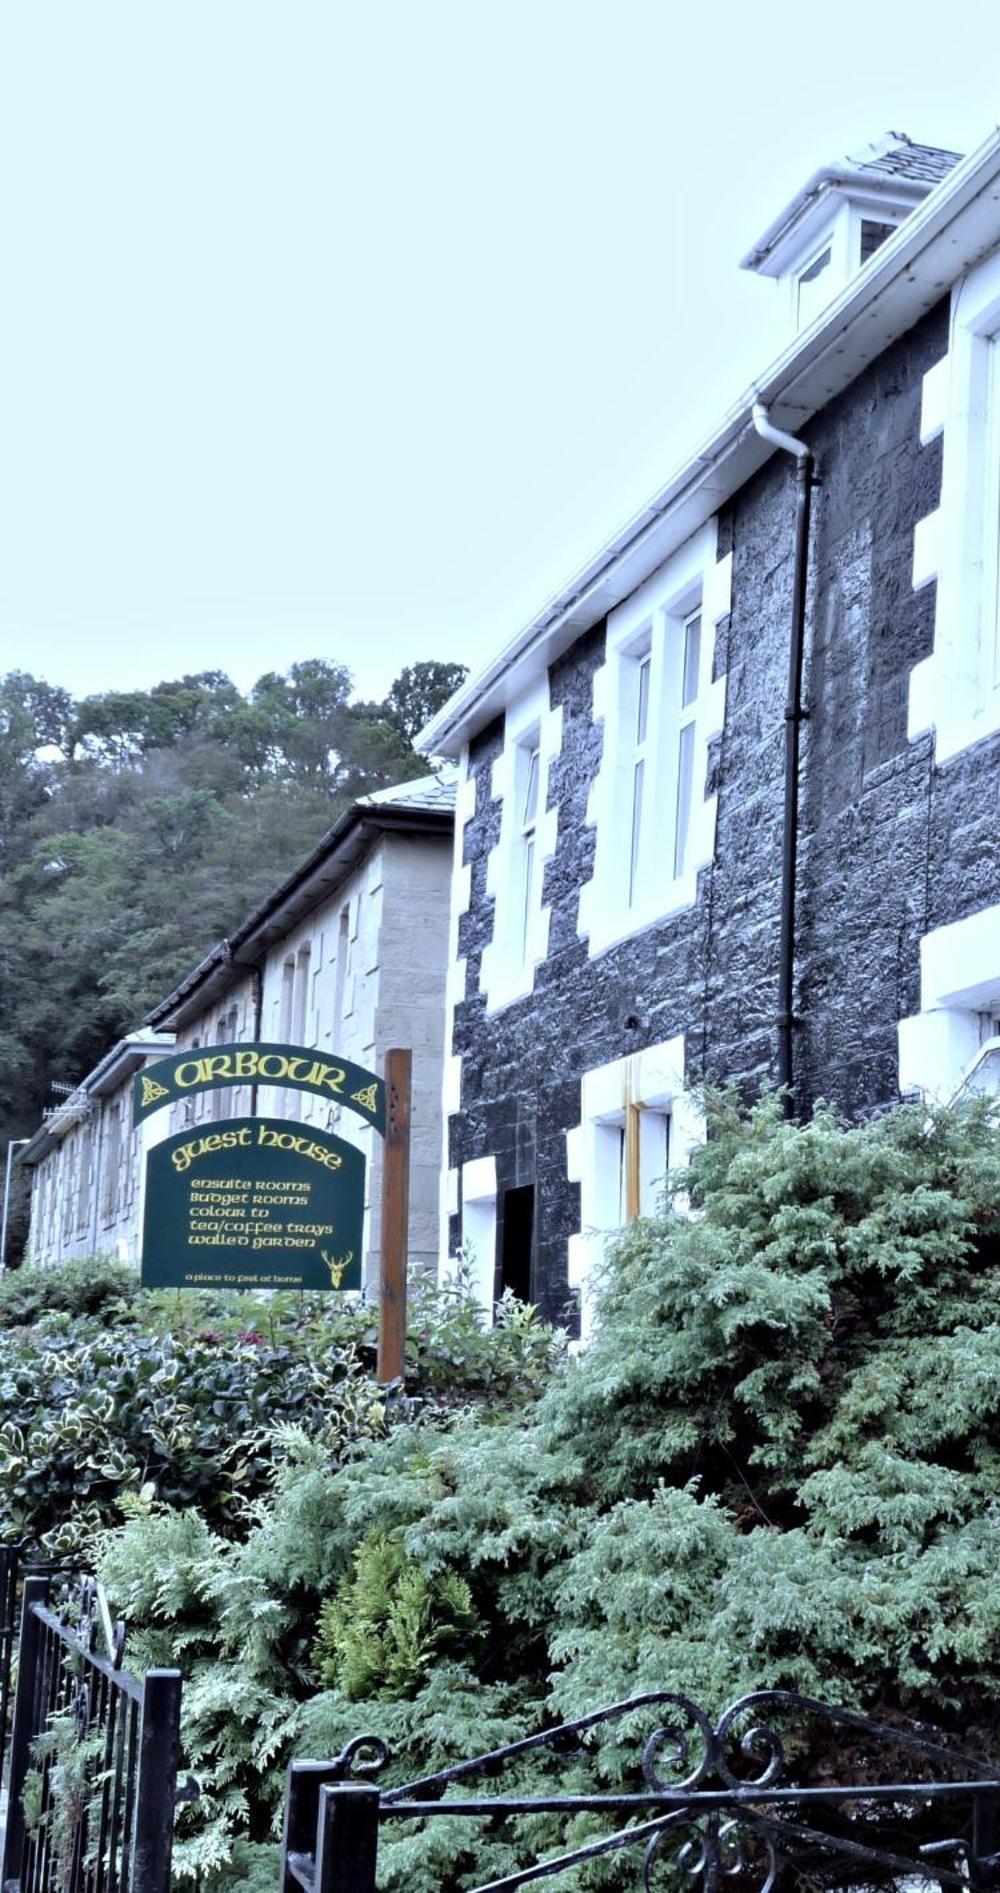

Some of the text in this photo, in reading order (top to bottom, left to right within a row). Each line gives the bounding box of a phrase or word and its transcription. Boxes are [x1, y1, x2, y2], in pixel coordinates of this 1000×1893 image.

[174, 1051, 346, 1093] ARBOUR
[171, 1125, 343, 1172] guest house
[190, 1178, 311, 1191] ensuite rooms
[252, 1195, 308, 1205] rooms
[189, 1205, 246, 1217] colour
[189, 1220, 333, 1236] tea/coffee trays
[188, 1234, 316, 1249] walled garden
[194, 1274, 222, 1282] place
